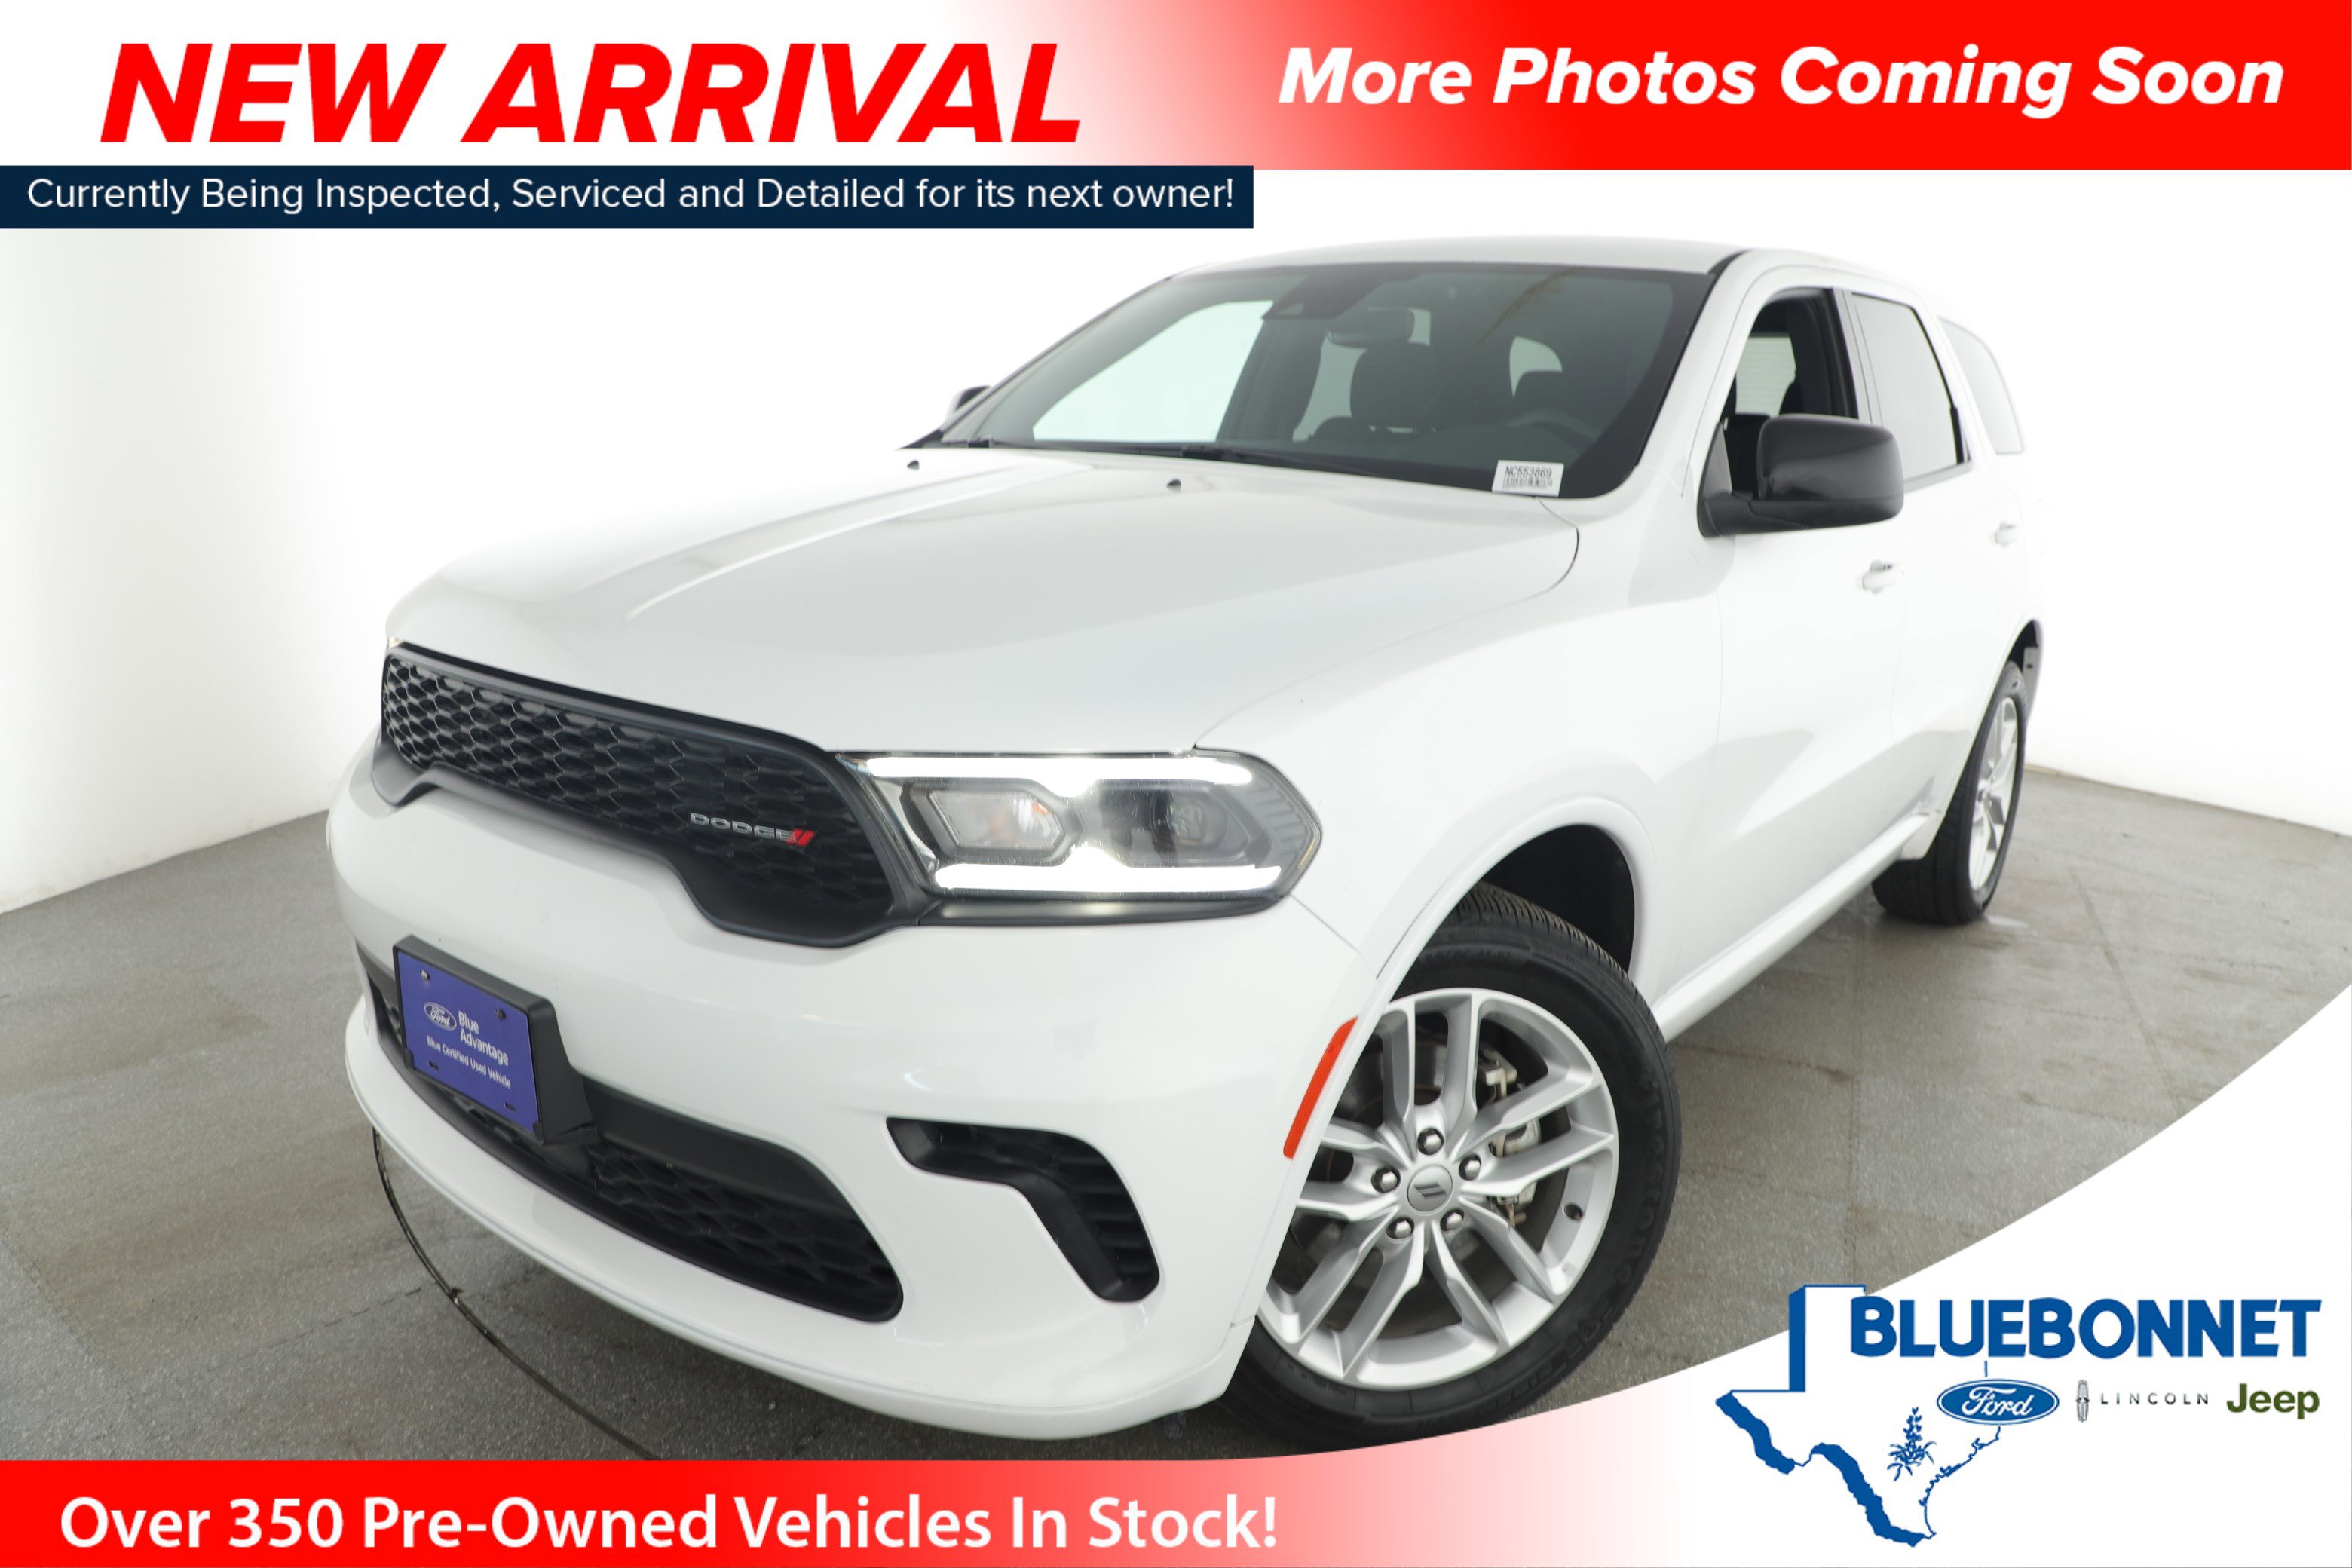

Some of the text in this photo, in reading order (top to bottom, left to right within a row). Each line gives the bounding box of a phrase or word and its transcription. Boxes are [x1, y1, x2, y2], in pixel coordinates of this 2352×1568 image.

[690, 812, 796, 843] DODGE
[458, 1010, 479, 1034] Blue
[427, 1035, 511, 1089] Blue Certified Used Vehicle
[460, 1027, 509, 1066] Advantage
